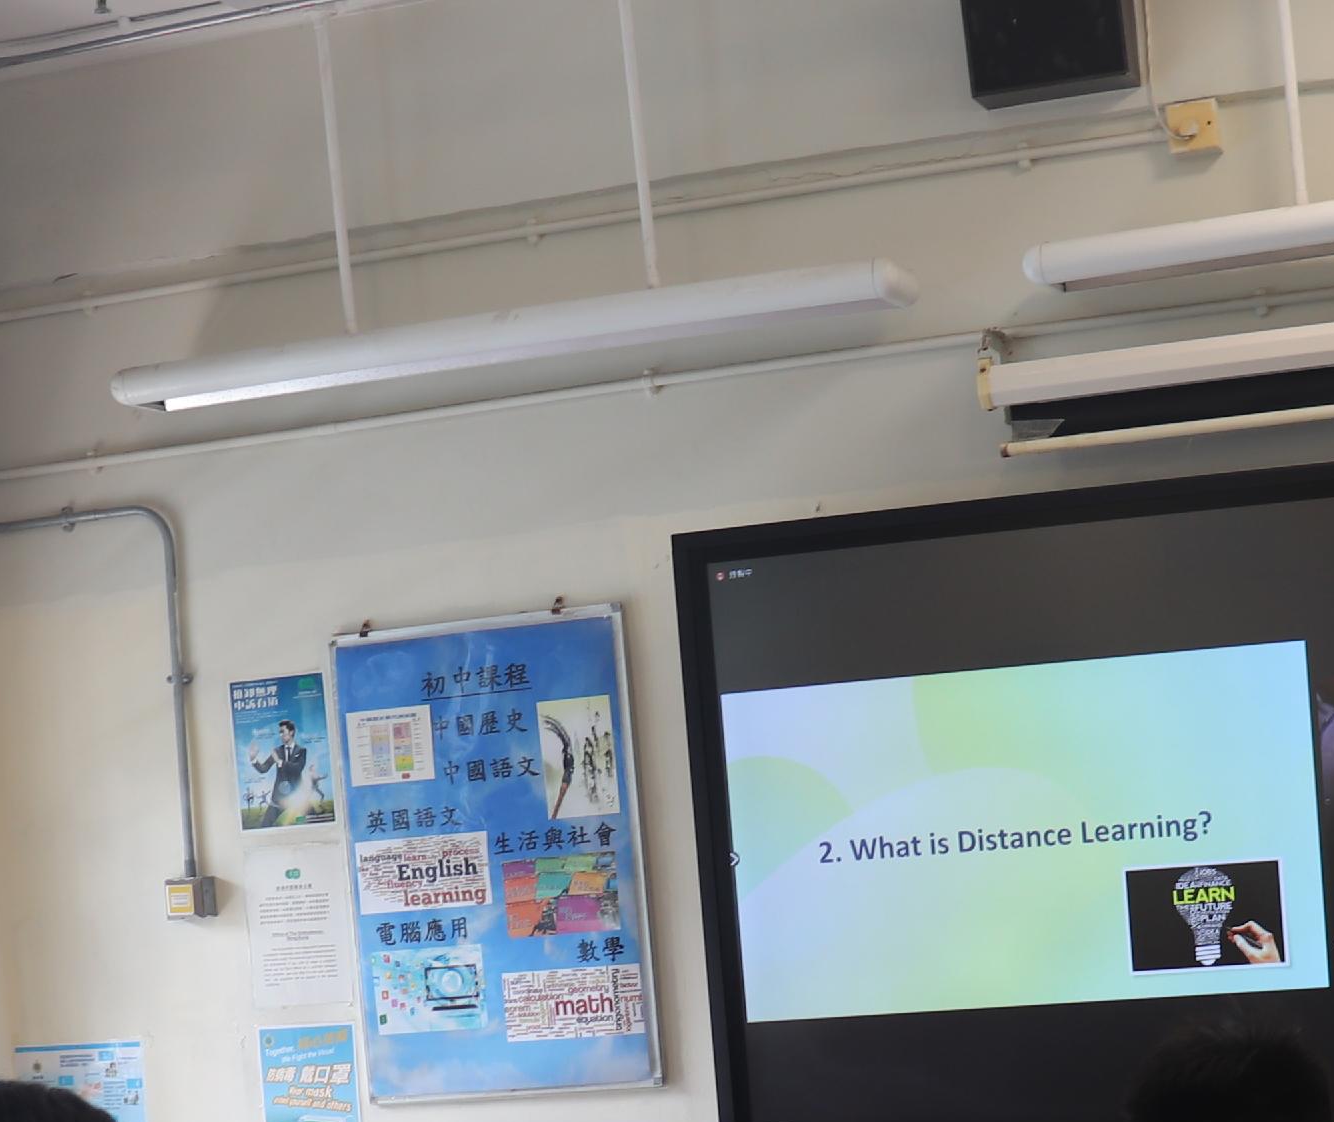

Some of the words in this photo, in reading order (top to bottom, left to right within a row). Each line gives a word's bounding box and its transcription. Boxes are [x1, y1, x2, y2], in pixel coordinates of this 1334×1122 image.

[421, 663, 530, 697] 初中課程
[434, 709, 528, 739] 中國歷史
[444, 757, 540, 785] 中國語文
[367, 806, 462, 835] 英國語文
[494, 822, 616, 855] 生活與社會
[819, 841, 842, 864] 2.
[850, 836, 922, 861] What
[930, 833, 949, 855] is
[958, 827, 1072, 852] Distance
[1081, 811, 1212, 844] Learning?
[360, 853, 403, 863] language
[404, 854, 427, 862] learn
[442, 848, 479, 859] process
[397, 857, 478, 882] English
[404, 886, 487, 907] learning
[1172, 886, 1235, 905] LEARN
[1196, 902, 1233, 912] FUTURE
[376, 917, 467, 945] 電腦應用
[577, 936, 624, 962] 數學
[568, 985, 609, 996] geometry
[555, 993, 614, 1016] math
[576, 1014, 613, 1025] equation
[305, 1084, 332, 1099] mask
